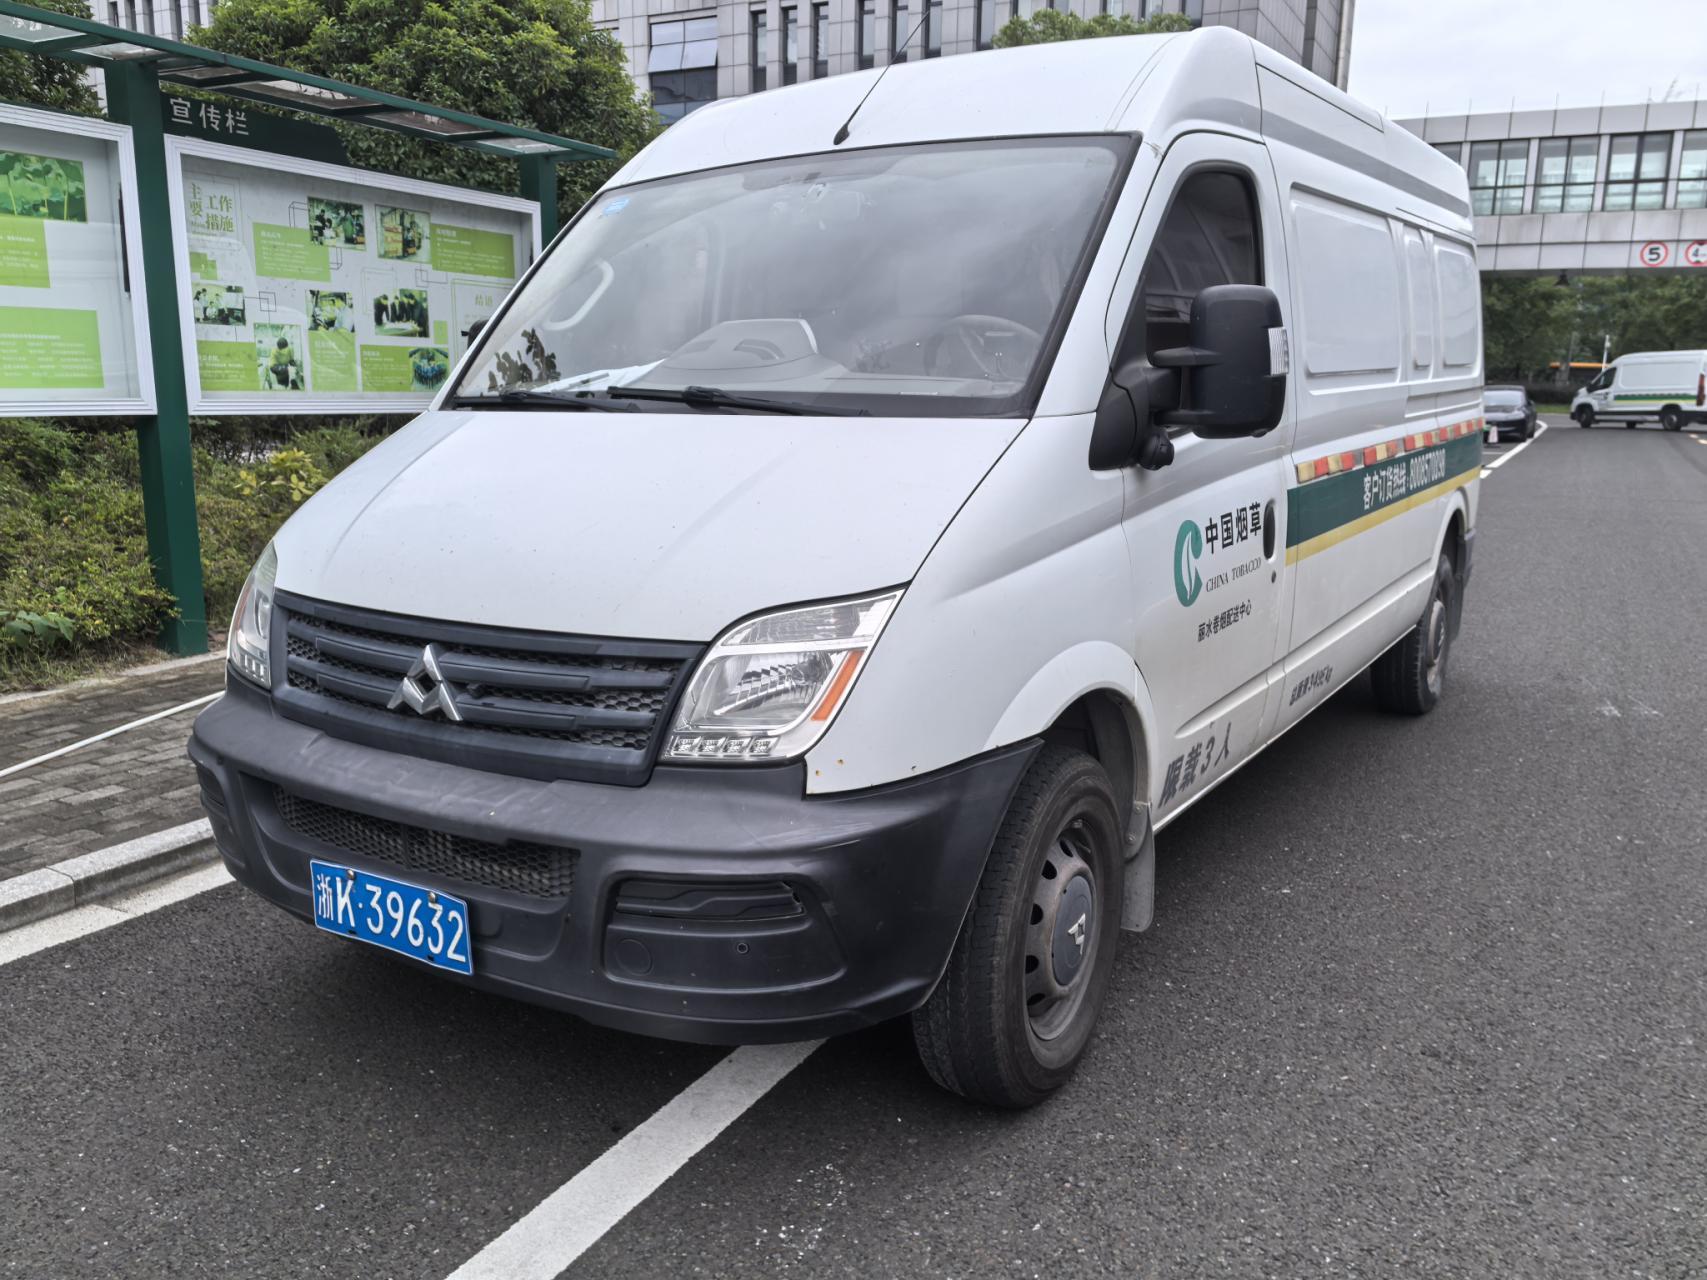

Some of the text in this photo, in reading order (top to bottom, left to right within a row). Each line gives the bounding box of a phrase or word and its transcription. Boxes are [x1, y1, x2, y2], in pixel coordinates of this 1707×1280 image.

[171, 98, 249, 135] 宣传栏
[207, 194, 233, 212] 工作
[1648, 247, 1660, 262] 5
[1205, 502, 1262, 554] 中国烟草
[1206, 557, 1262, 592] CHINA TOBACCO
[1198, 598, 1252, 642] 丽水卷烟配送中心
[1157, 721, 1231, 809] 限载3人
